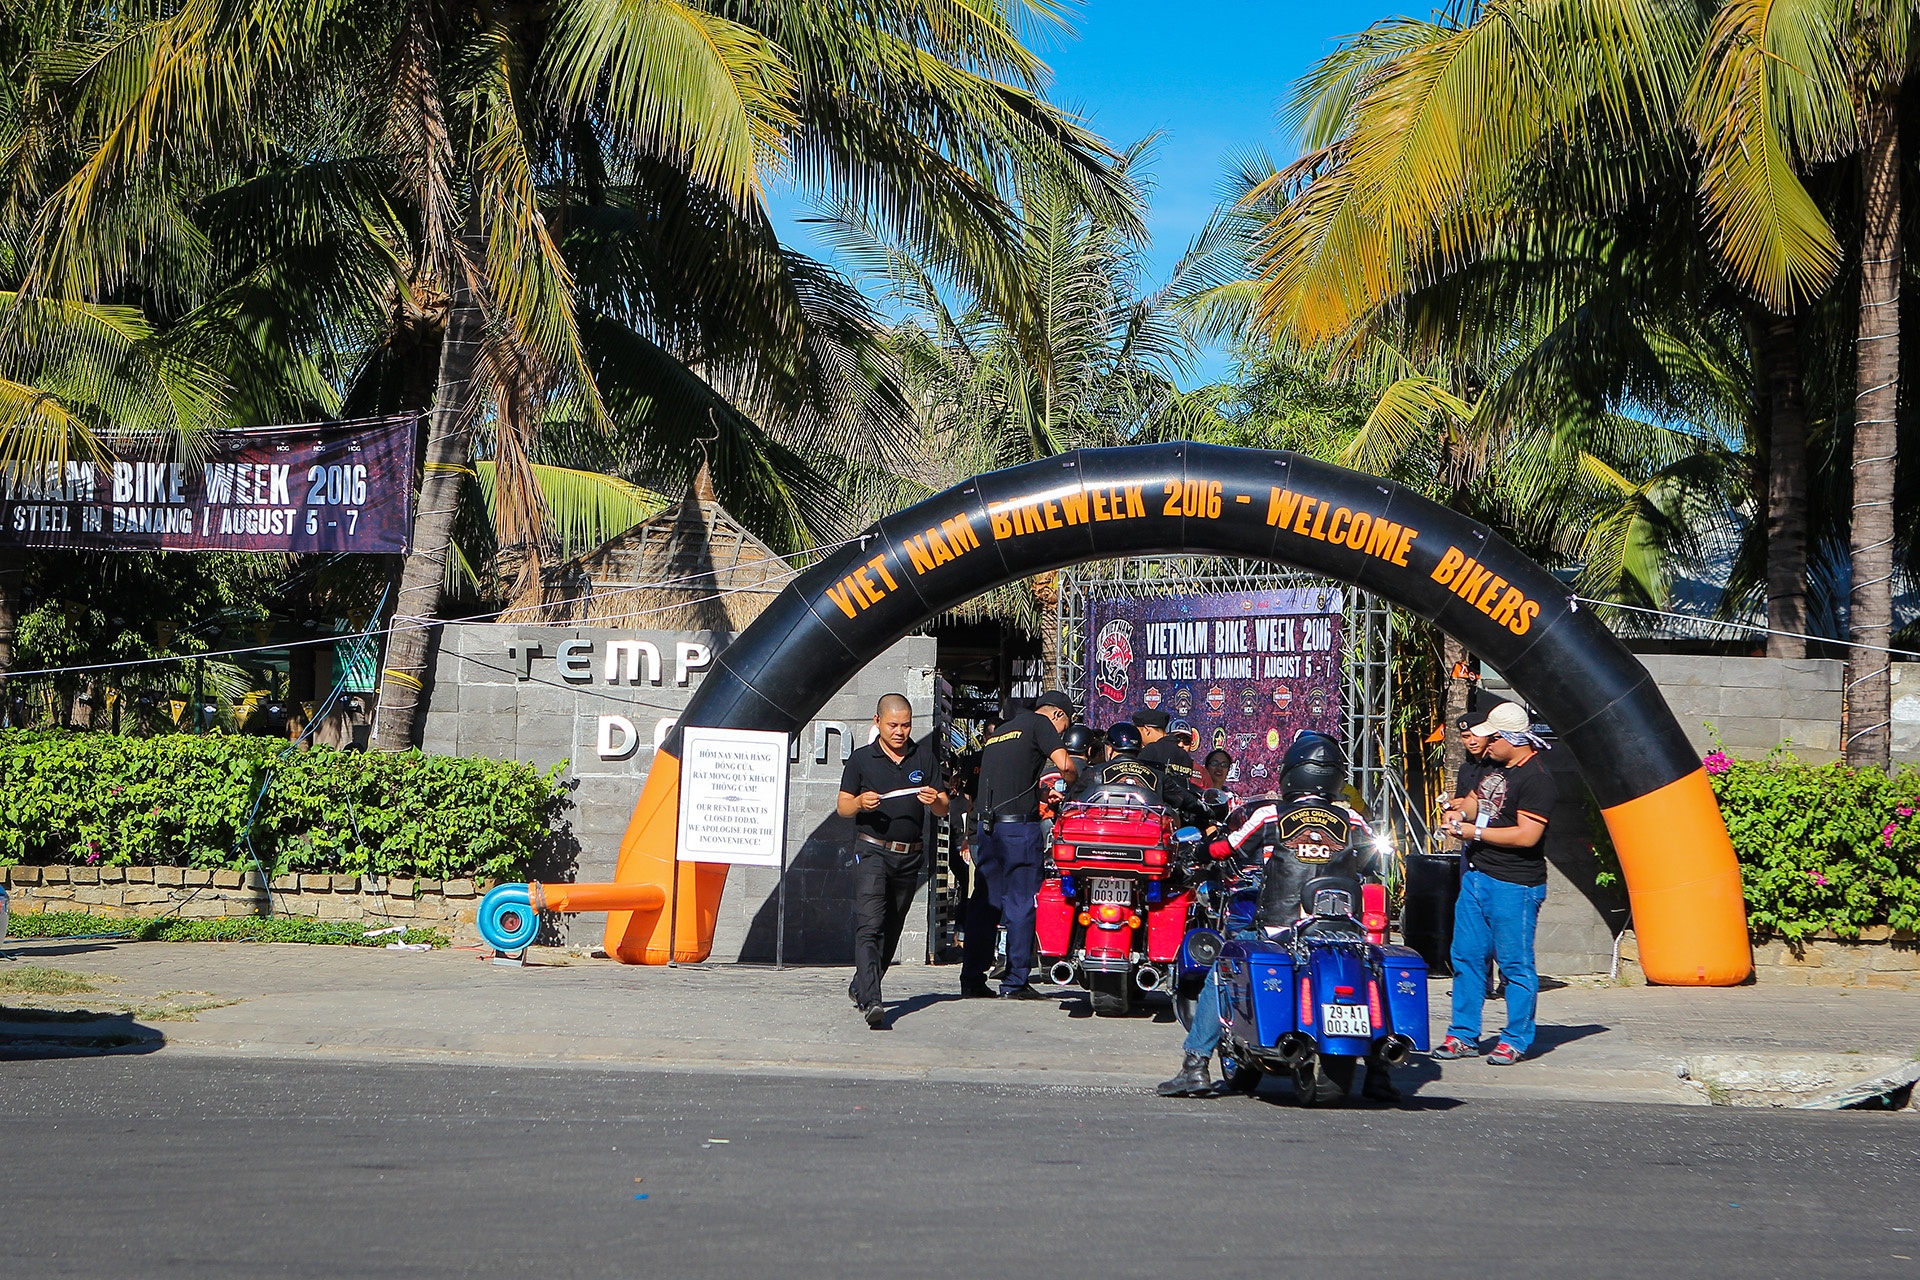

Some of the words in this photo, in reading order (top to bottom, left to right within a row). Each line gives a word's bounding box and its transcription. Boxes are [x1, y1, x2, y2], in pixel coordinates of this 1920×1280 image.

[112, 461, 185, 503] BIKE
[204, 462, 290, 505] WEEK
[307, 463, 367, 506] 2016
[13, 505, 71, 531] STEEL
[82, 506, 103, 532] IN
[112, 506, 192, 535] DANANG
[219, 507, 295, 536] AUGUST
[305, 509, 317, 536] 5
[347, 509, 357, 536] 7
[825, 553, 899, 620] VIET
[902, 511, 981, 576] NAM
[987, 485, 1146, 541] BIKEWEEK
[1163, 479, 1223, 519] 2016
[1266, 486, 1419, 568] WELCOME
[1429, 544, 1541, 636] BIKERS
[1145, 621, 1208, 655] VIETNAM
[1215, 619, 1248, 654] BIKE
[1254, 618, 1295, 652] WEEK
[1302, 617, 1332, 652] 2016
[1145, 659, 1168, 681] REAL
[1170, 658, 1197, 680] STEEL
[1201, 658, 1211, 680] IN
[1215, 657, 1252, 680] DANANG
[1264, 656, 1301, 679] AUGUST
[1305, 655, 1312, 678] 5
[1325, 655, 1332, 678] 7
[718, 751, 732, 759] NAY
[709, 772, 731, 780] MONG
[696, 803, 712, 811] OUR
[713, 804, 759, 814] RESTAURANT
[704, 814, 733, 823] CLOSED
[734, 815, 759, 824] TODAY.
[1290, 811, 1310, 822] HANOI
[1311, 810, 1338, 824] CHAPTER
[1301, 816, 1328, 825] VIETNAM
[688, 823, 700, 831] WE
[701, 824, 742, 834] APOLOGISE
[743, 827, 758, 835] FOR
[759, 828, 774, 836] THE
[699, 835, 761, 846] INCONVENIENCE!
[1297, 843, 1331, 858] HOG
[1097, 879, 1125, 890] 29-A1
[1094, 889, 1129, 902] 003.07
[1329, 1005, 1363, 1019] 29-A1
[1326, 1020, 1368, 1034] 003.46
